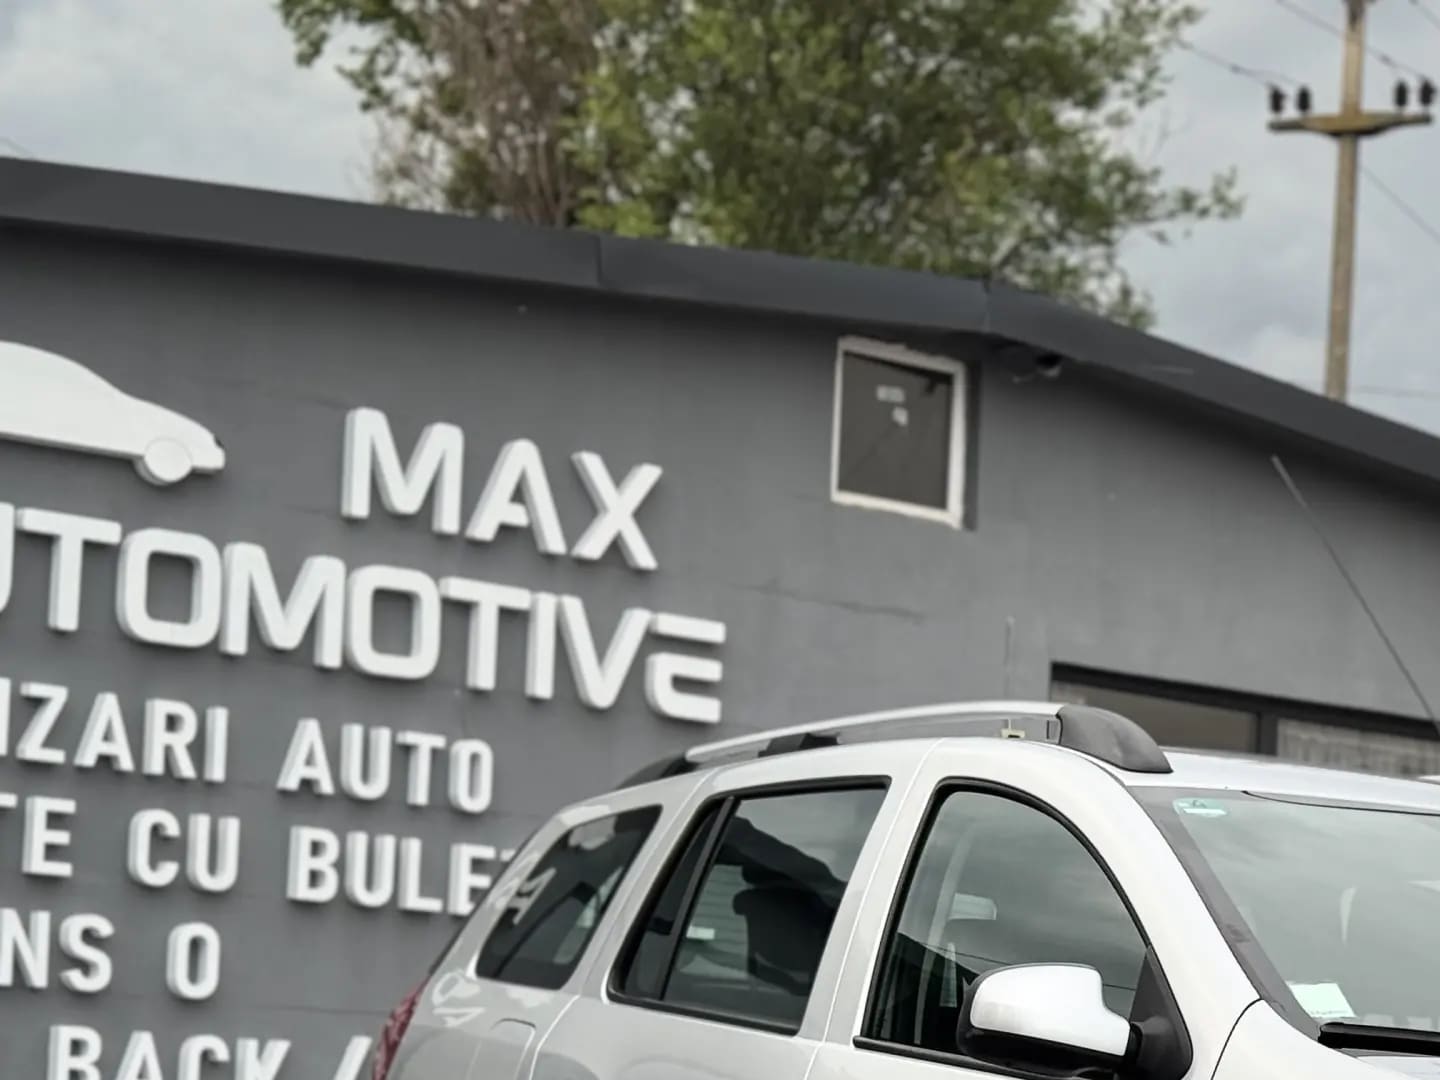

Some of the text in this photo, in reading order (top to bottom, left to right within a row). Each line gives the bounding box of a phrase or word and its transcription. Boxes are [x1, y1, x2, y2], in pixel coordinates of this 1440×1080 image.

[340, 407, 663, 570] MAX
[0, 499, 726, 723] TOMOTIVE
[0, 677, 494, 814] ZARI AUTO
[128, 809, 240, 892] CU
[287, 826, 516, 917] BULE
[166, 922, 221, 1001] O
